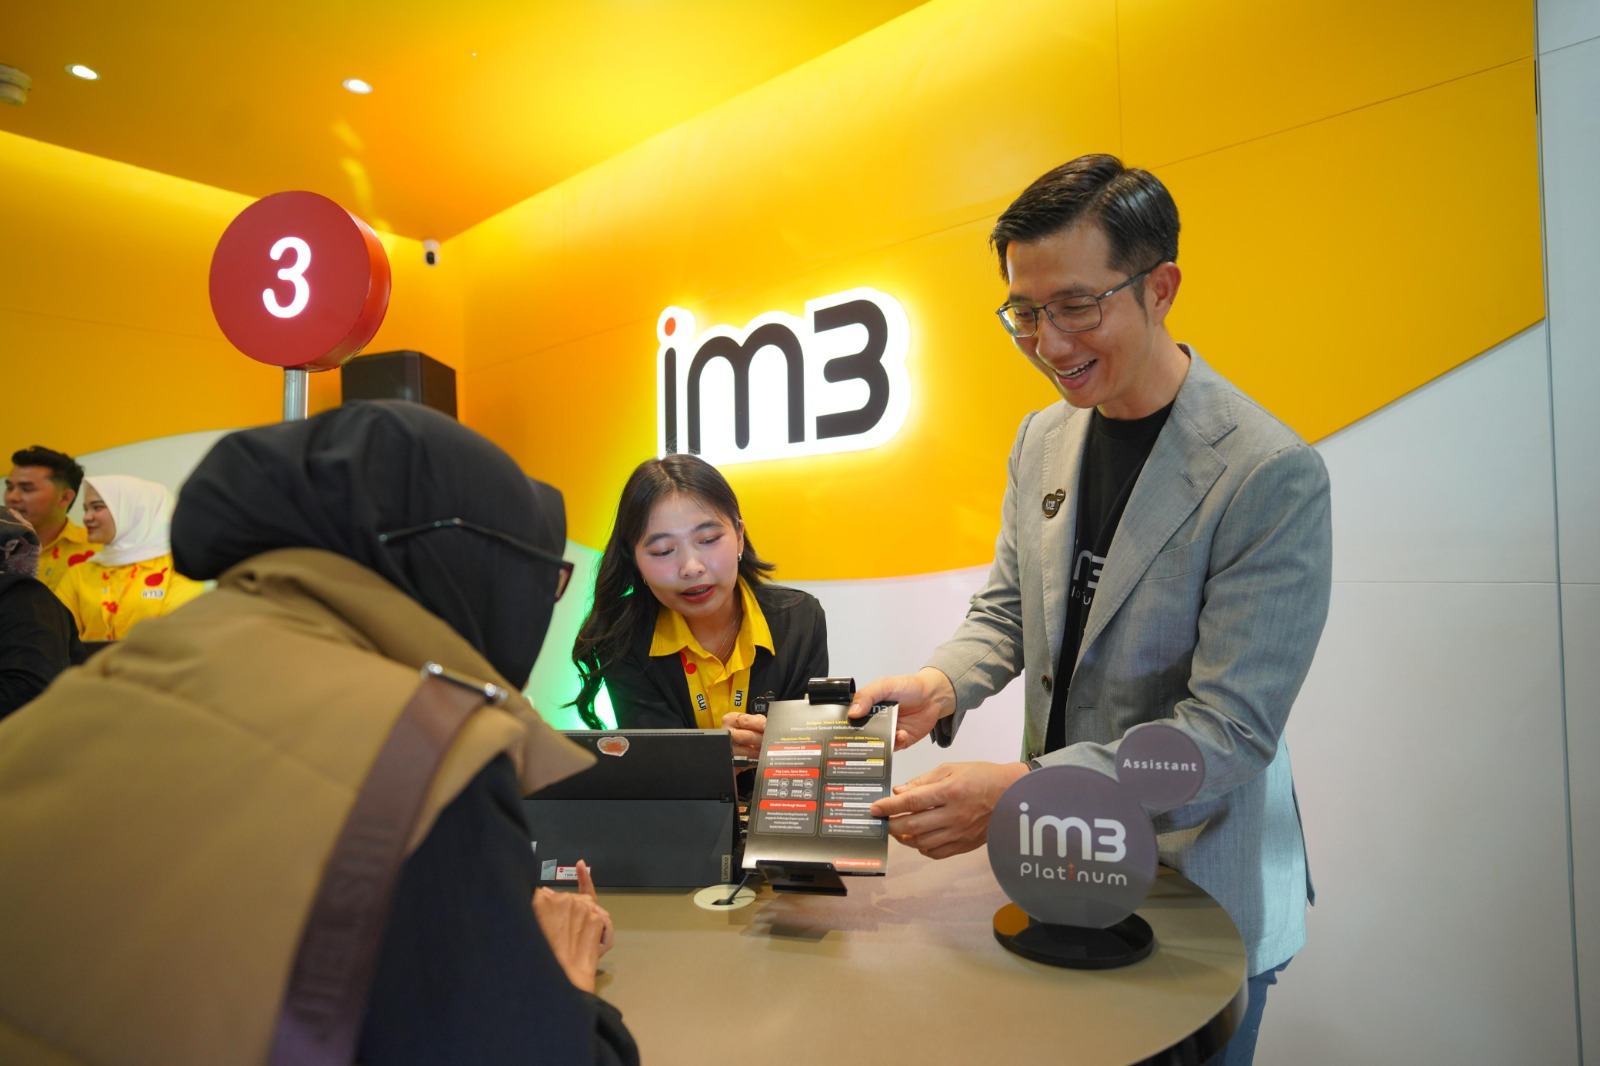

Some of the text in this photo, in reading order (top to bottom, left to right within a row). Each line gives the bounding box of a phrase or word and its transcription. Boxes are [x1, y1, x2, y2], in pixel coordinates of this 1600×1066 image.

[262, 236, 312, 319] 3
[664, 299, 890, 455] im3
[1123, 758, 1198, 772] Assistant
[1019, 802, 1127, 863] im3
